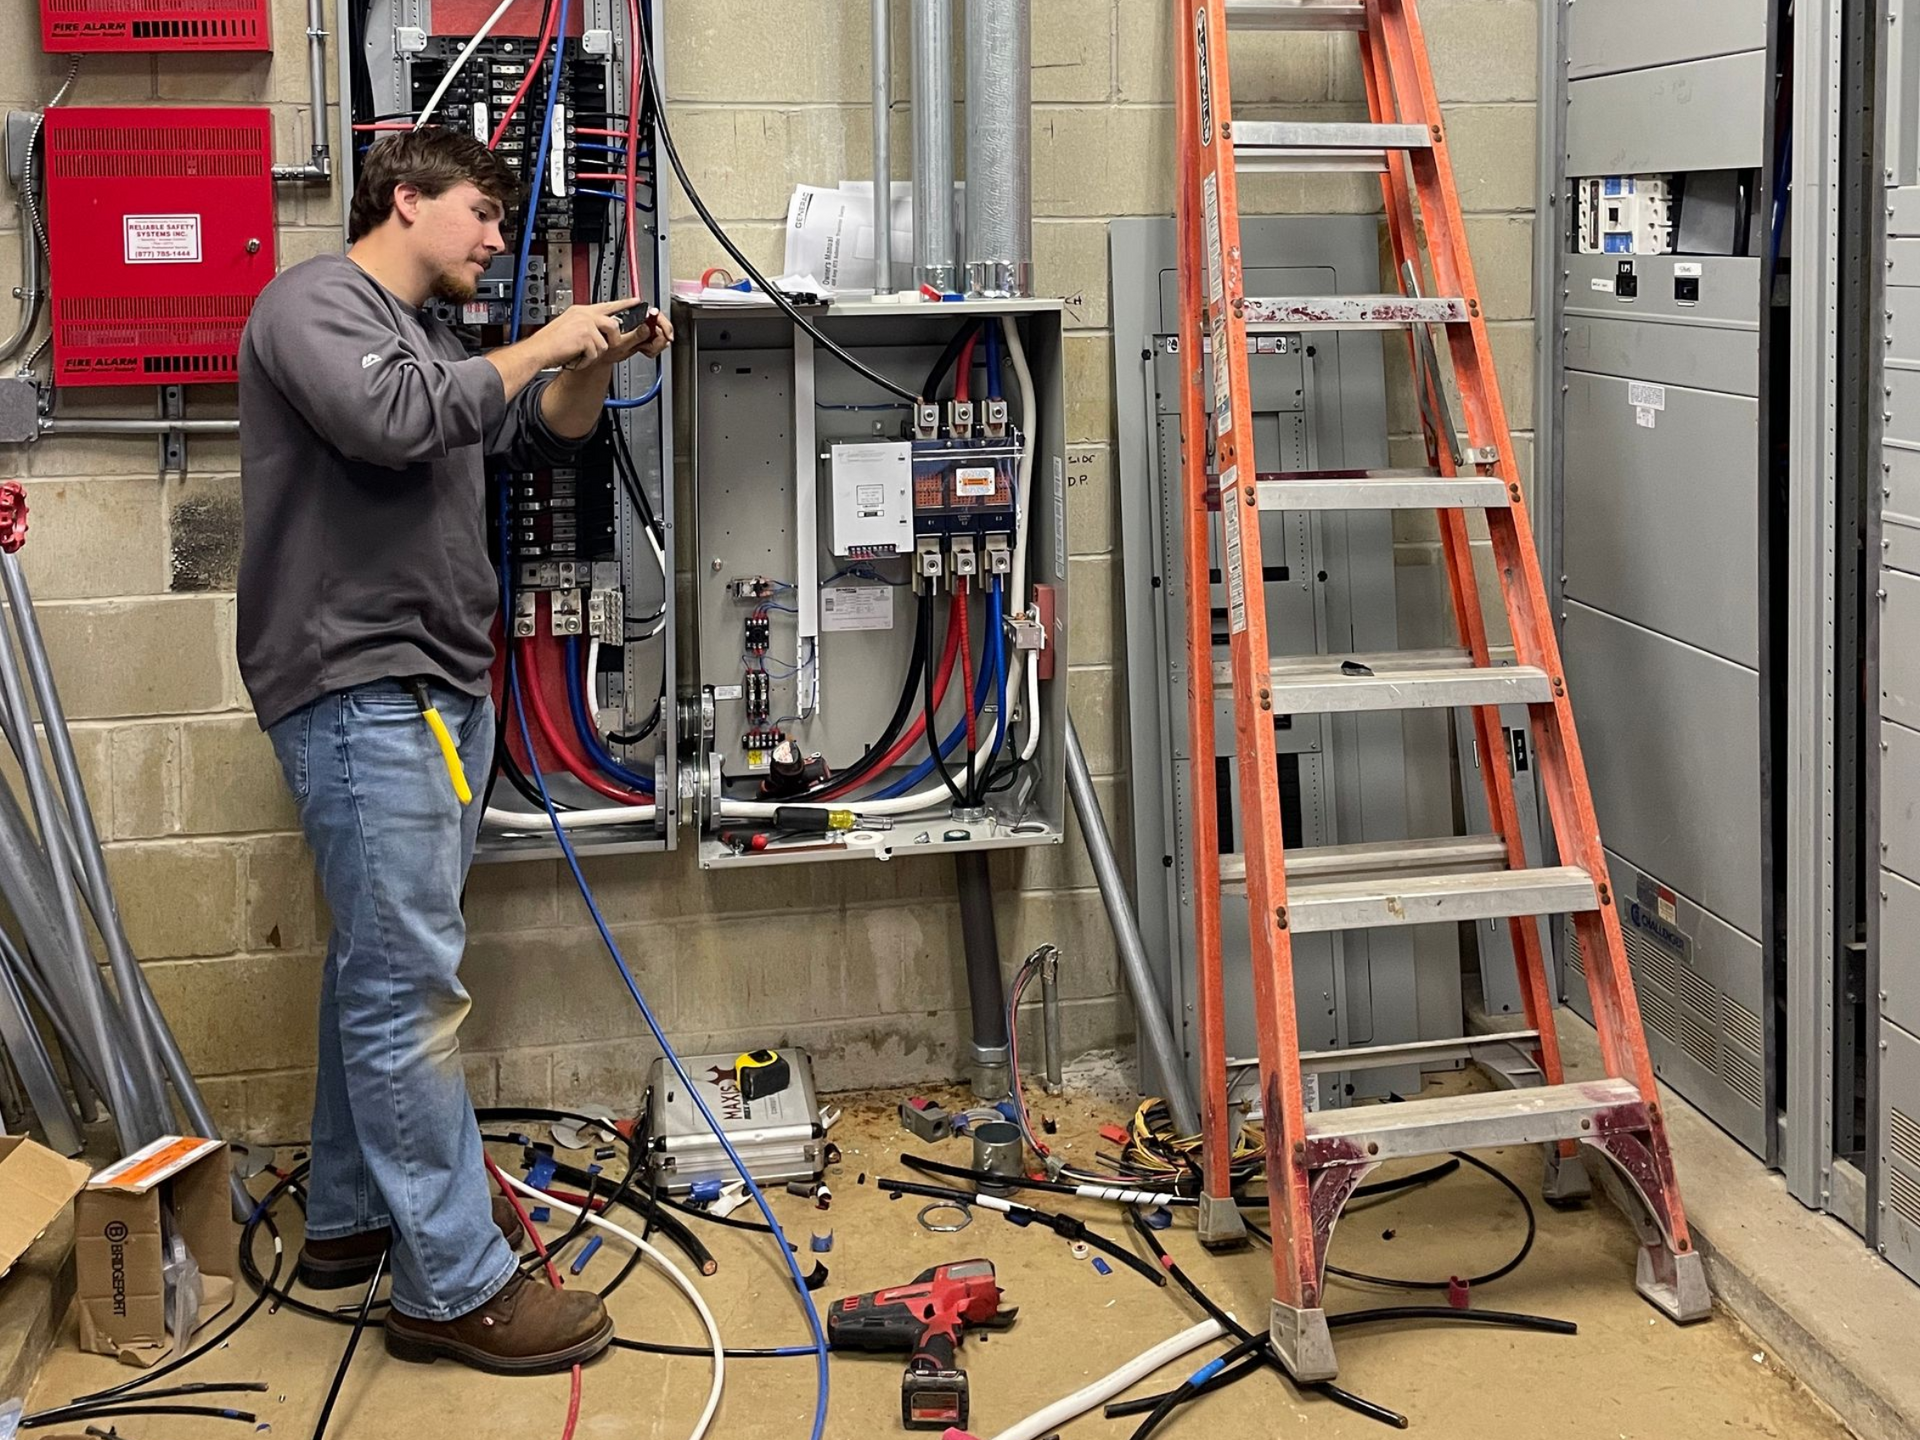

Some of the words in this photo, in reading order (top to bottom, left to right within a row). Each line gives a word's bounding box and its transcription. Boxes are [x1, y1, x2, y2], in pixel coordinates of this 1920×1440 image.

[53, 22, 79, 31] FIRE
[83, 22, 126, 31] ALARM
[795, 192, 809, 229] GENERAC
[824, 236, 834, 260] Manual
[1620, 263, 1631, 273] LPS
[65, 358, 92, 367] FIRE
[95, 357, 137, 366] ALARM
[720, 1085, 742, 1120] MAXIS
[111, 1244, 127, 1318] BRIDGEPORT
